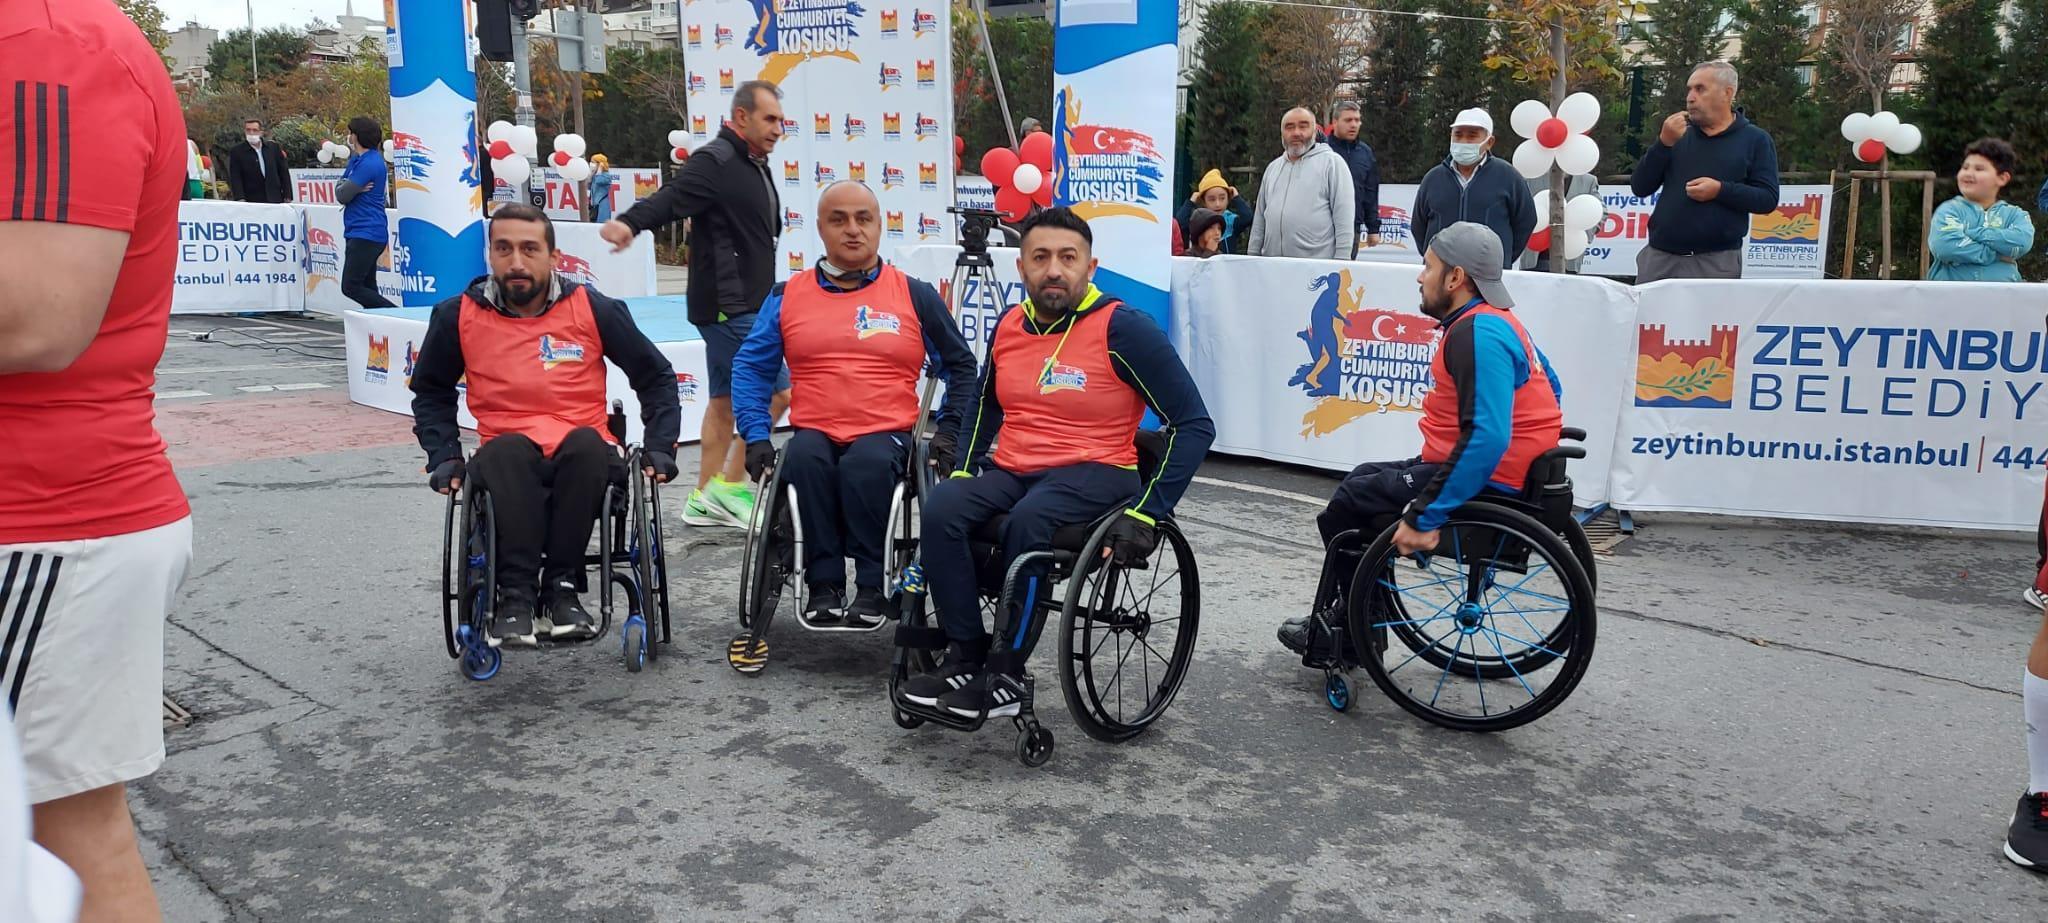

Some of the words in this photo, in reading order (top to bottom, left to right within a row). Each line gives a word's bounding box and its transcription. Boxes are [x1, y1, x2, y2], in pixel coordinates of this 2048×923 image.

[777, 26, 849, 62] KOŞUSU
[545, 182, 621, 211] TAT
[1068, 181, 1138, 208] KOŞUSU
[234, 273, 261, 284] 444
[266, 273, 297, 284] 1984
[1752, 324, 2048, 374] ZEYTiNBU
[1631, 431, 1969, 468] zeytinburnu.istanbul
